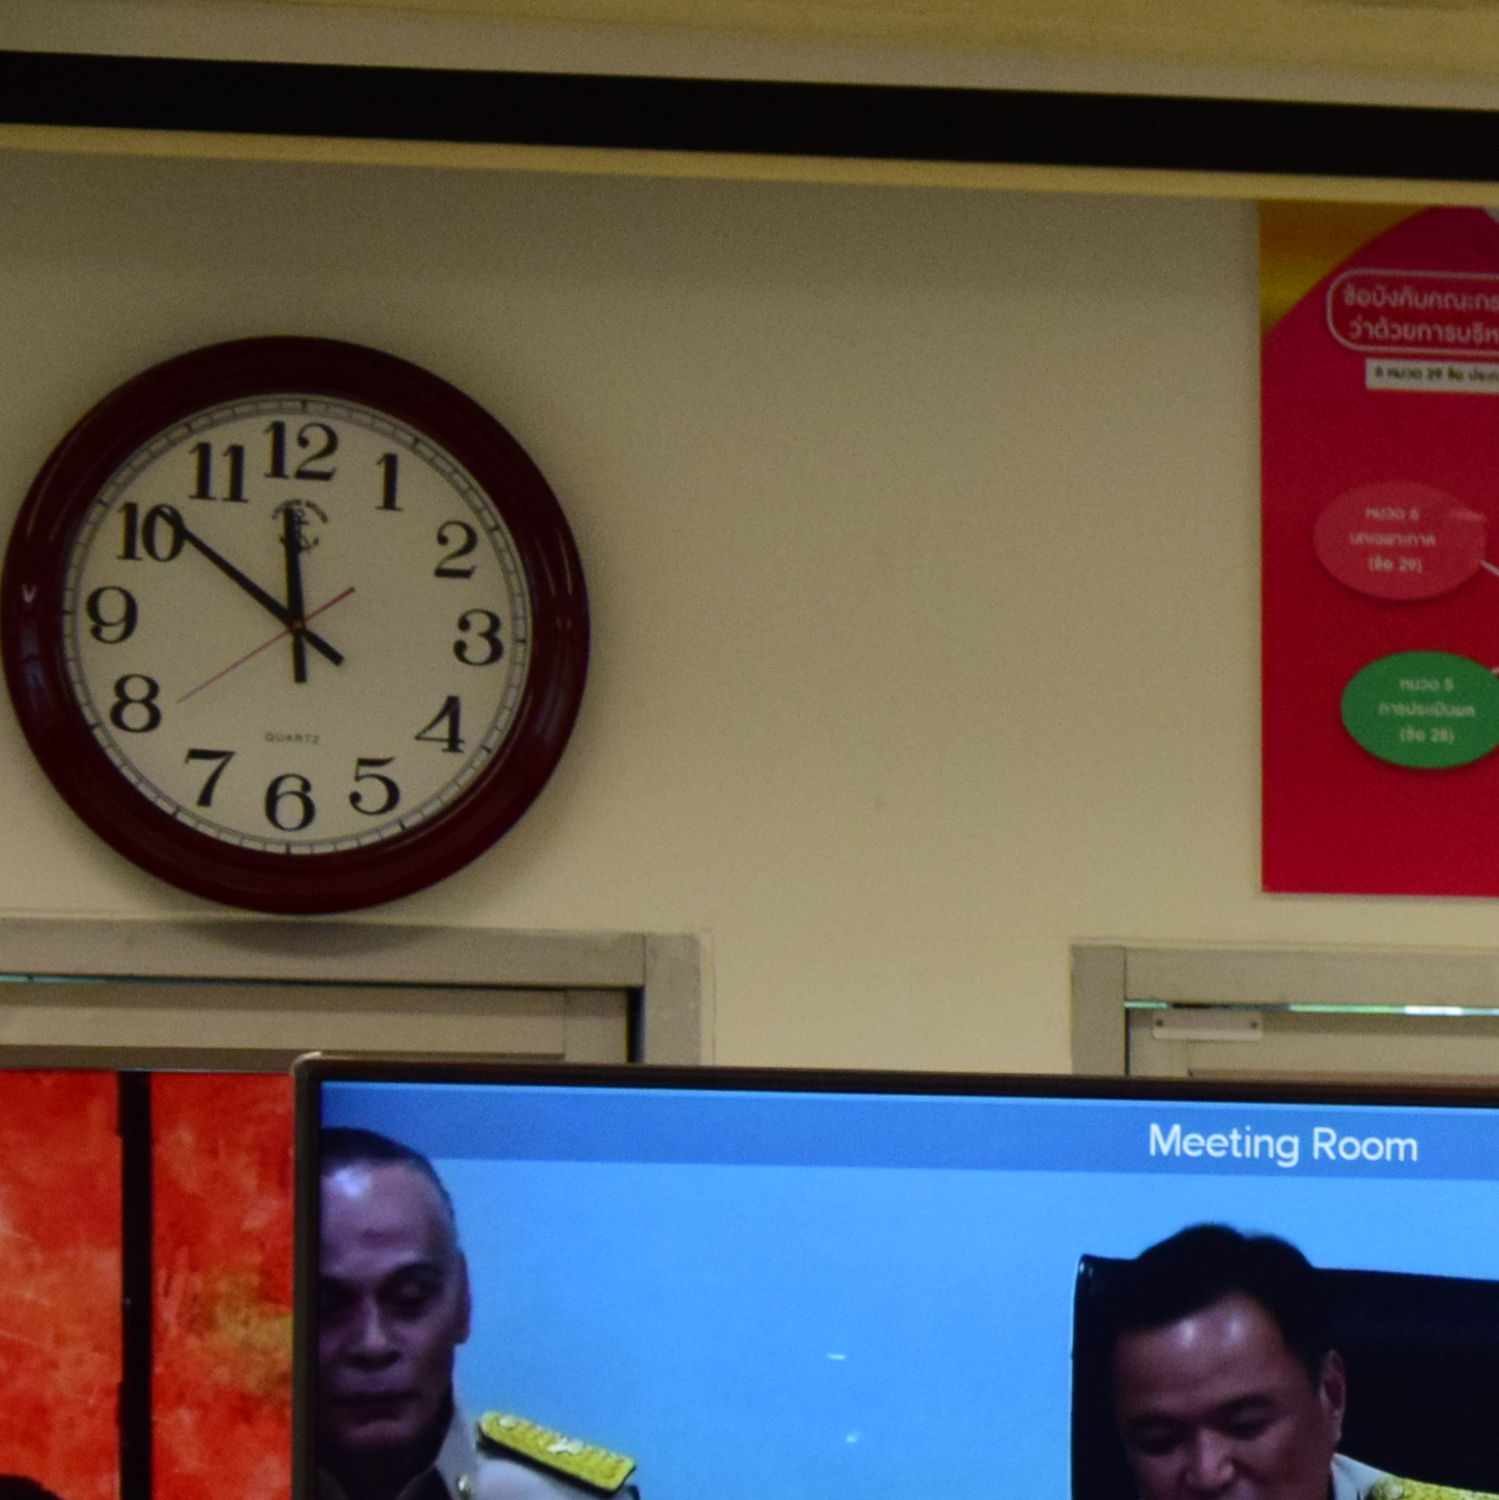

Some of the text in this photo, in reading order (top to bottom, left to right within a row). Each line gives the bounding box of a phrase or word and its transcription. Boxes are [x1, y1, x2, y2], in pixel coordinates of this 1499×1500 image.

[189, 442, 249, 503] 11
[263, 421, 338, 481] 12
[376, 453, 402, 511] 1
[116, 501, 188, 562] 10
[434, 521, 478, 579] 2
[86, 586, 138, 643] 9
[453, 609, 503, 666] 3
[110, 674, 161, 733] 8
[415, 695, 465, 753] 4
[184, 748, 235, 807] 7
[264, 774, 316, 831] 6
[349, 757, 400, 815] 5
[1149, 1123, 1419, 1166] Meeting Room
